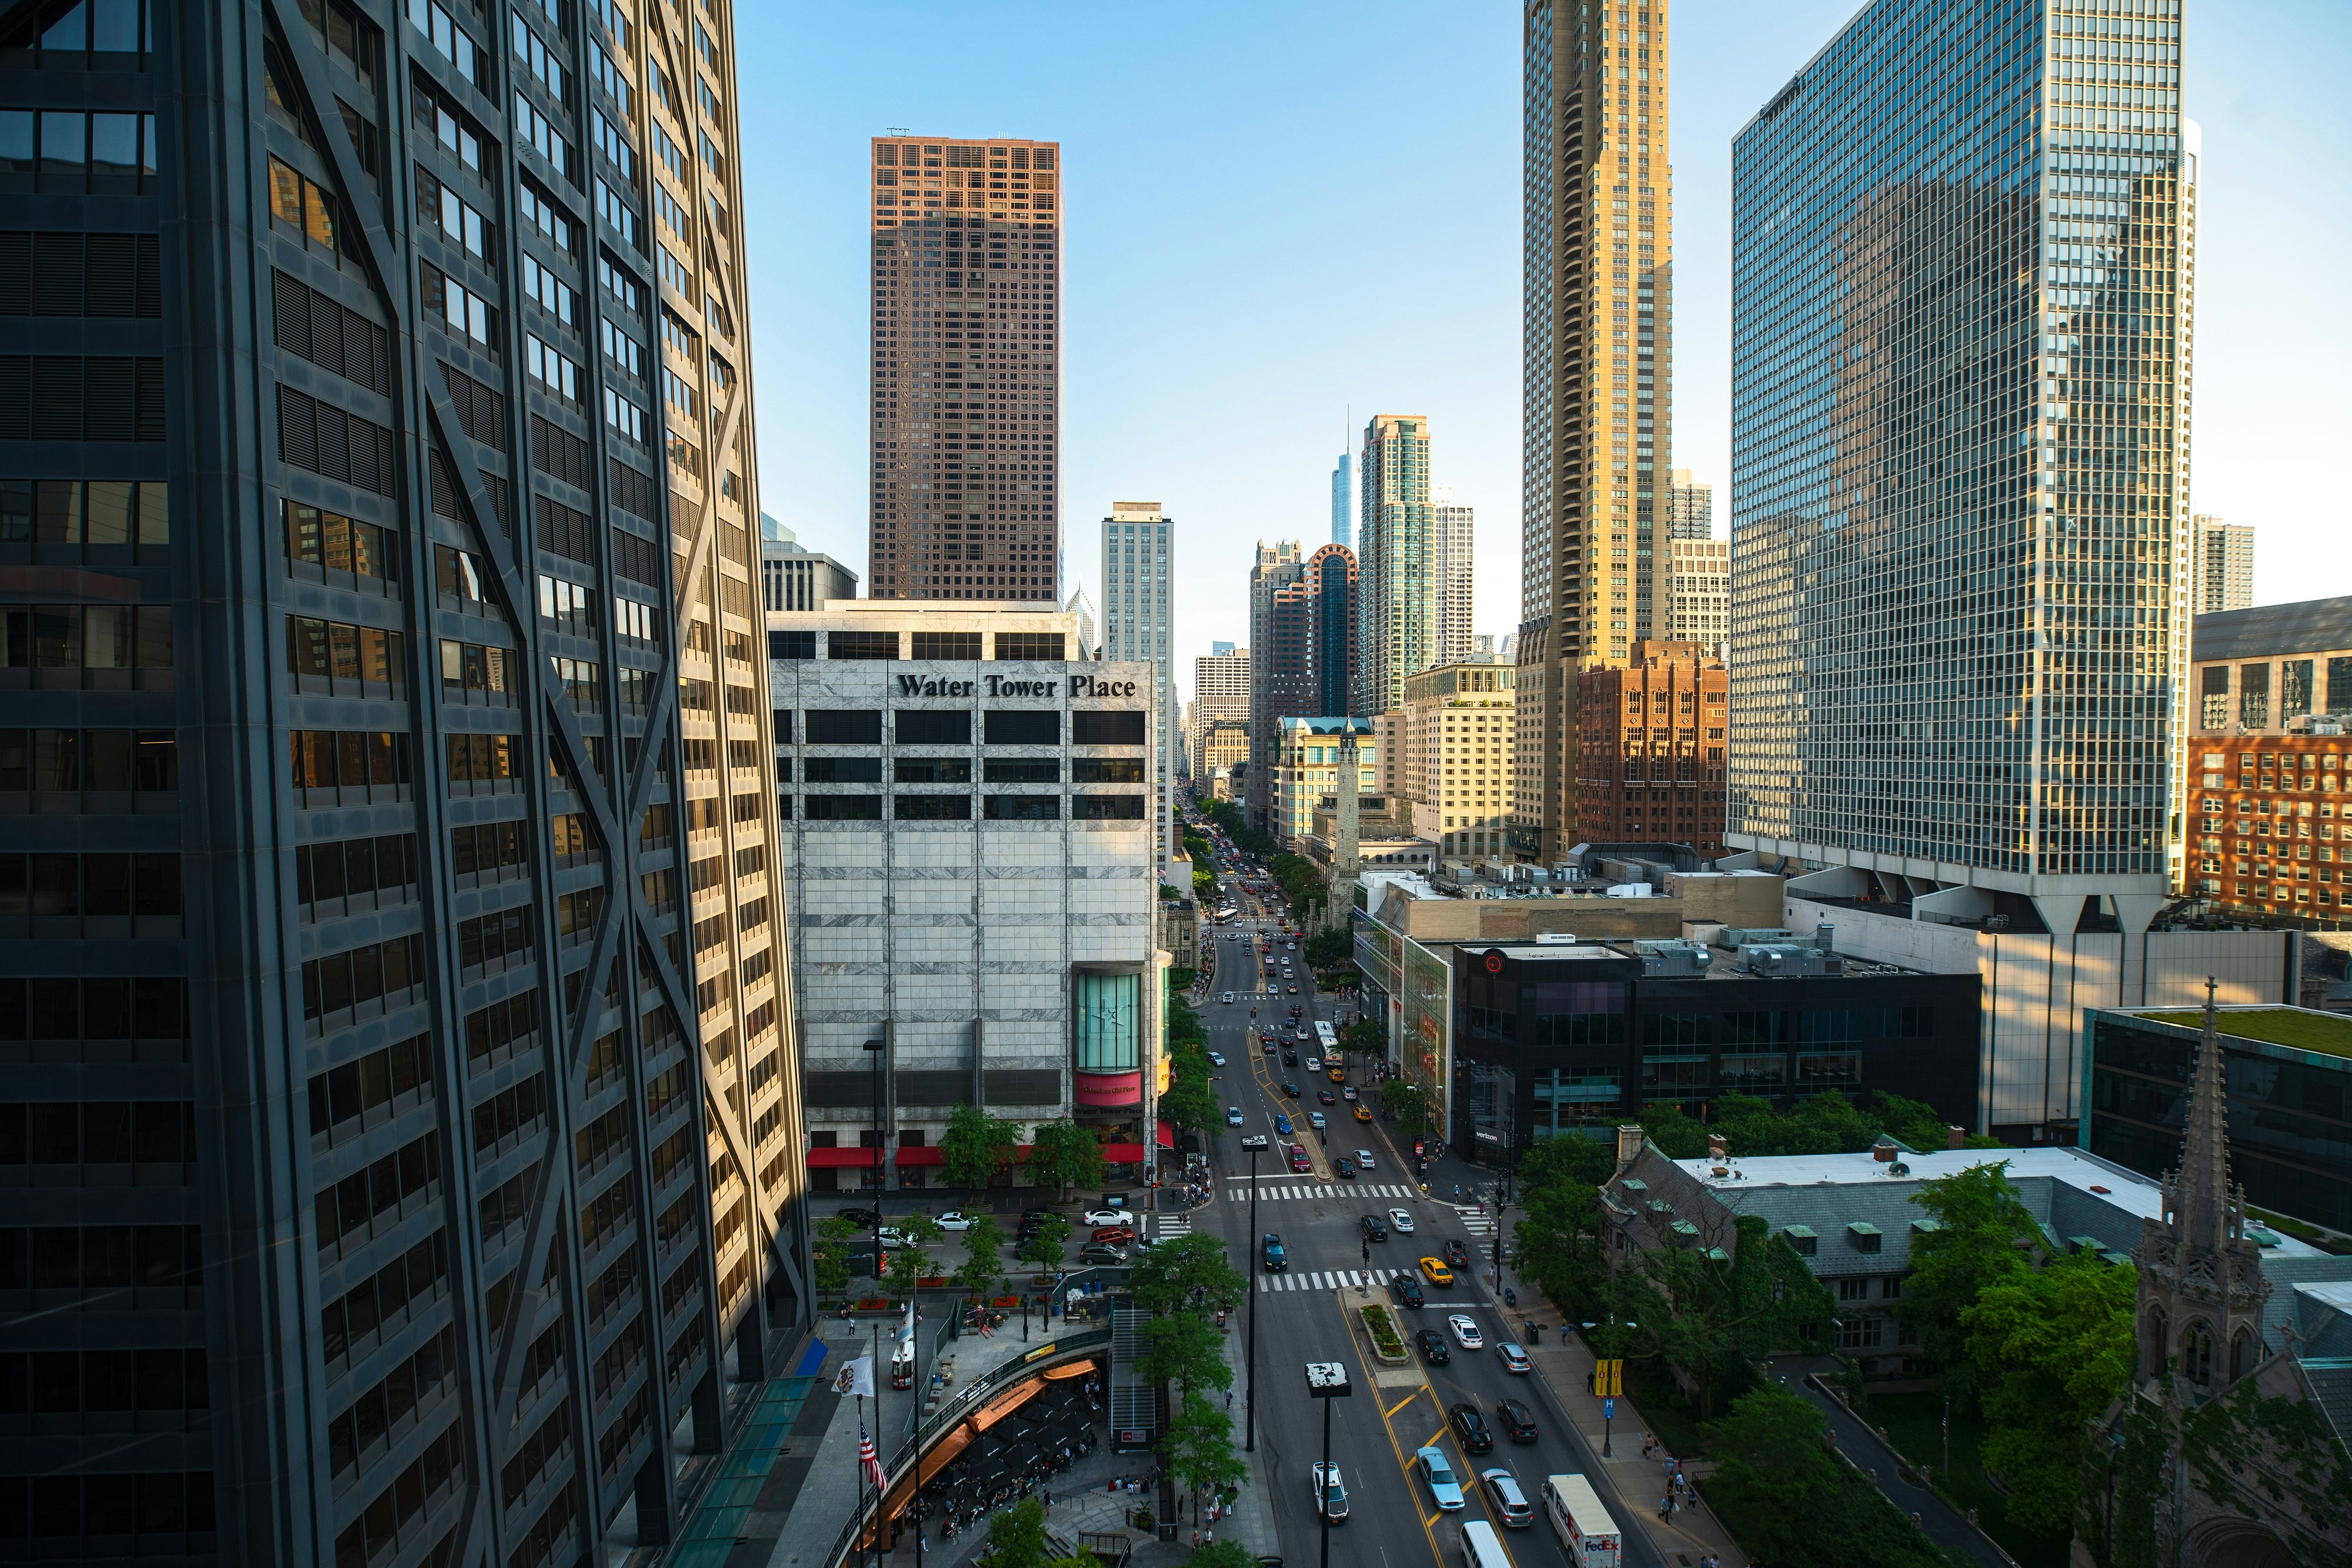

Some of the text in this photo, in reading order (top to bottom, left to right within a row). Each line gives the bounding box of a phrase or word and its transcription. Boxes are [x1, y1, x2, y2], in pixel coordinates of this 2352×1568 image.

[897, 674, 1136, 697] Water Tower Place
[1476, 1132, 1497, 1141] verizon
[973, 1405, 983, 1415] THE
[1014, 1372, 1037, 1388] FACTORY
[1556, 1492, 1580, 1547] FedEx
[1585, 1540, 1619, 1552] FedEx
